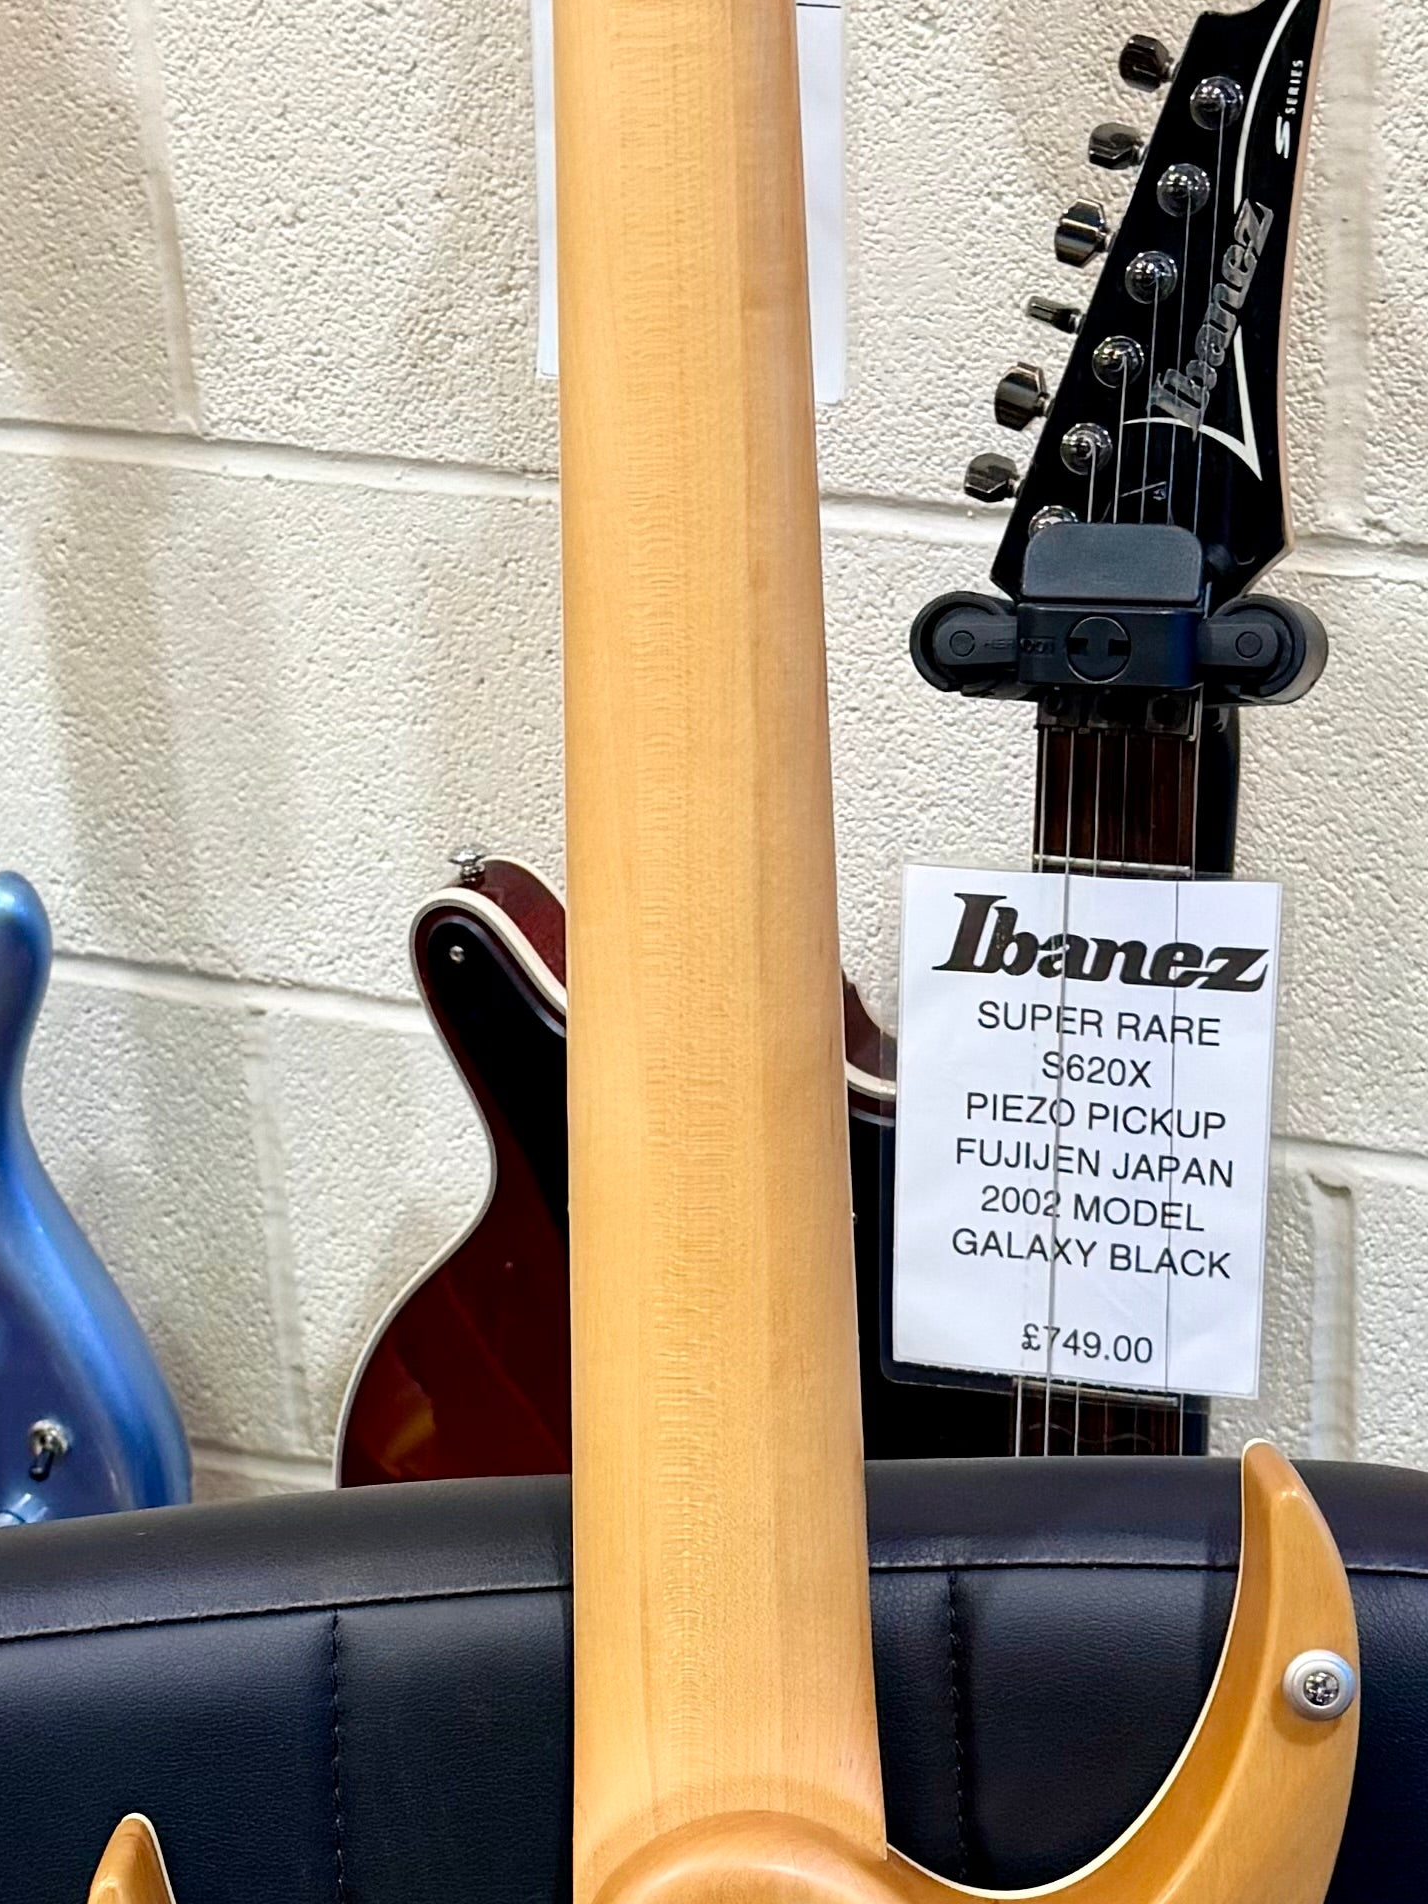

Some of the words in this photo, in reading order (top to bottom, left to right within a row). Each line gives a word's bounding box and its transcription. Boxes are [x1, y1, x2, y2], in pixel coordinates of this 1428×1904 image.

[1284, 59, 1305, 115] SERIES
[1149, 198, 1273, 441] Ibanez
[932, 892, 1269, 993] Ibanez
[977, 1000, 1103, 1039] SUPER
[1117, 1011, 1221, 1047] RARE
[1042, 1051, 1152, 1089] S620X
[966, 1092, 1075, 1128] PIEZO
[1087, 1103, 1226, 1139] PICKUP
[956, 1138, 1101, 1178] FUJIJEN
[1112, 1154, 1234, 1188] JAPAN
[980, 1185, 1061, 1218] 2002
[1073, 1194, 1205, 1232] MODEL
[952, 1229, 1097, 1268] GALAXY
[1110, 1243, 1232, 1280] BLACK
[1021, 1322, 1154, 1365] £749.00
